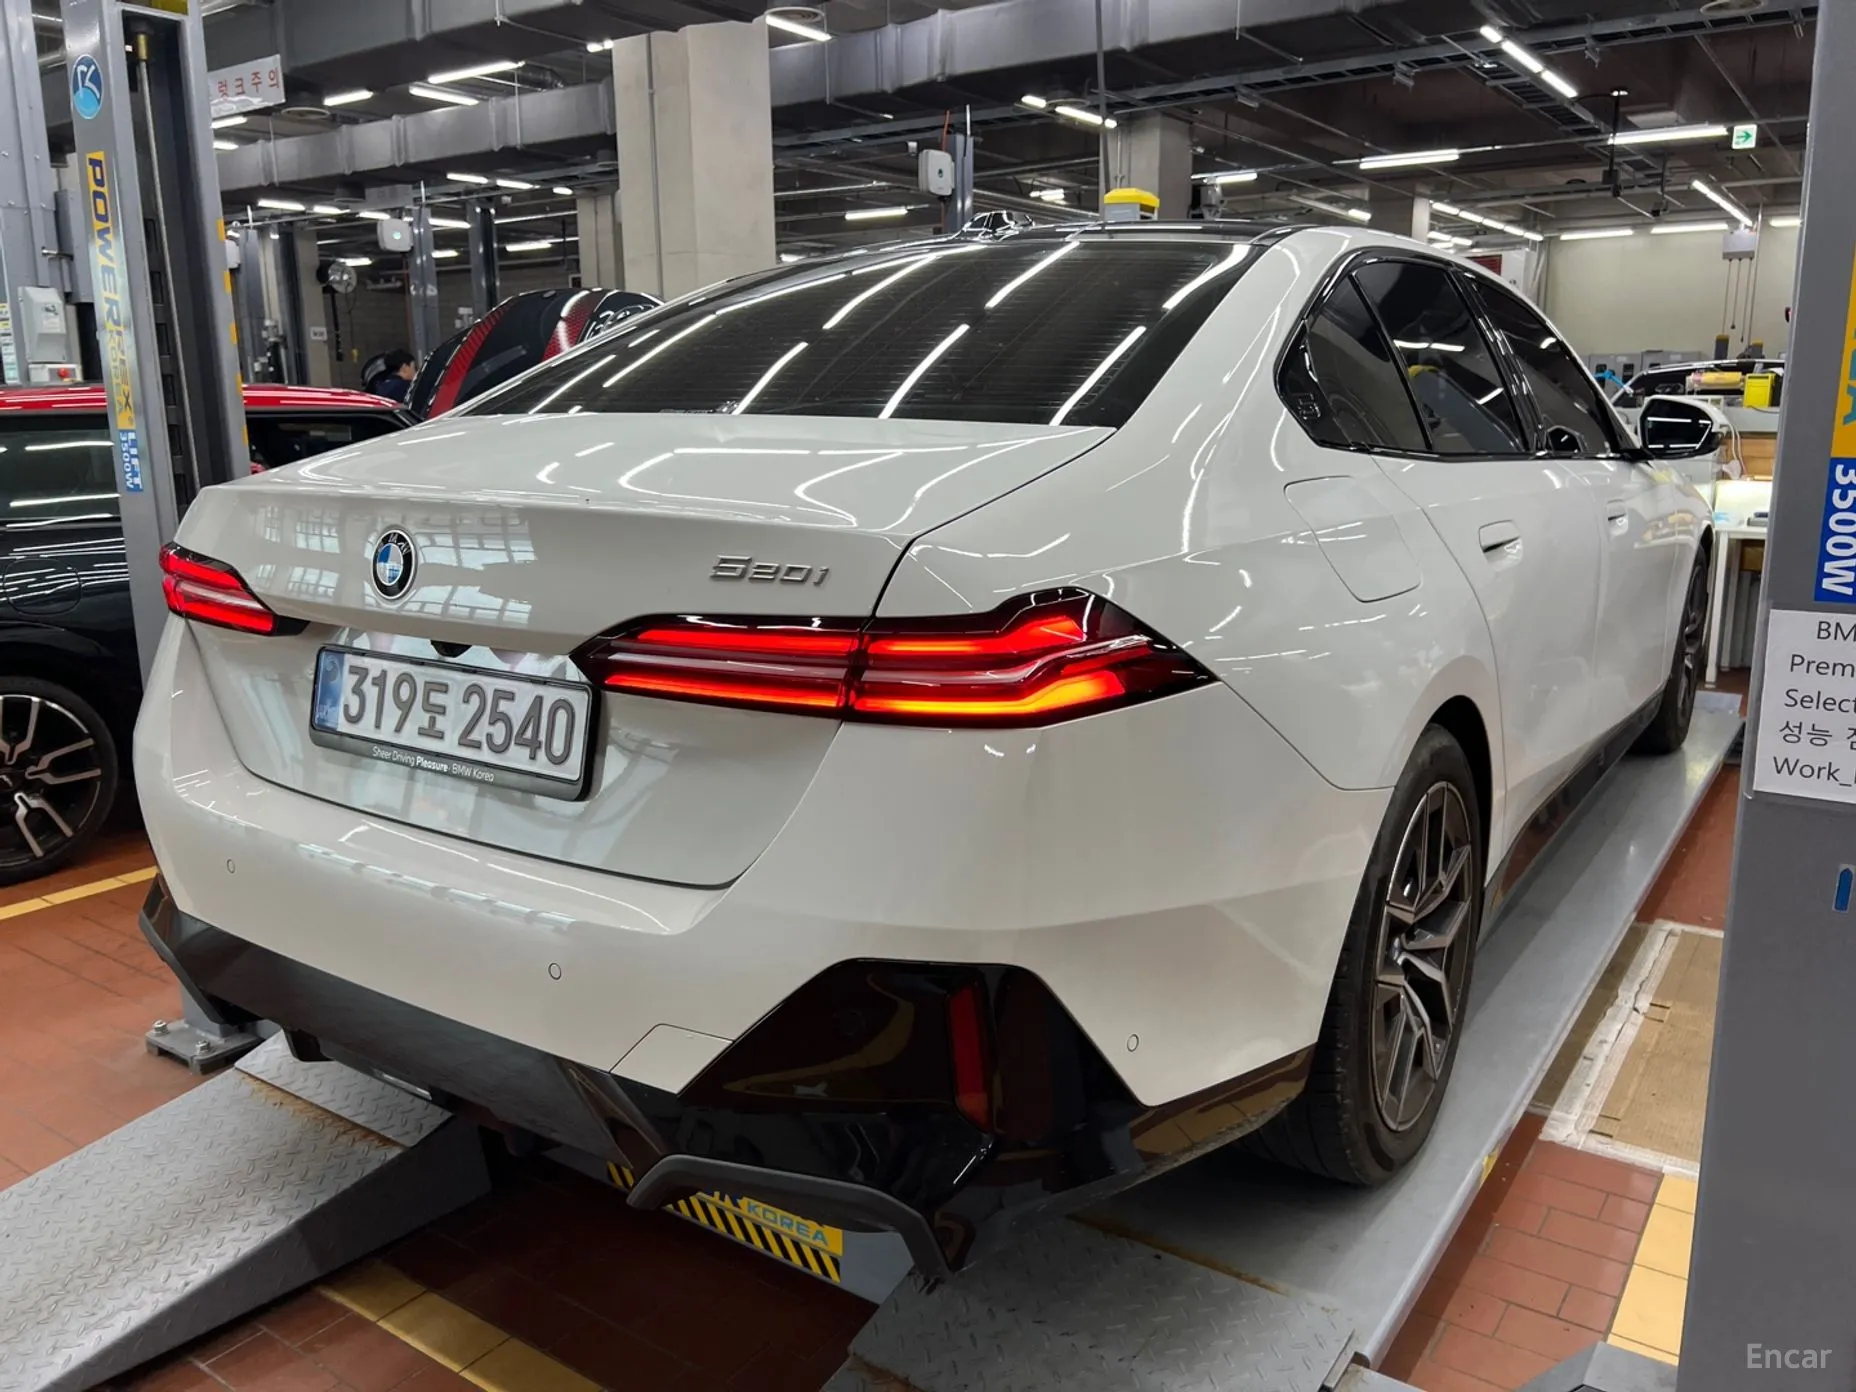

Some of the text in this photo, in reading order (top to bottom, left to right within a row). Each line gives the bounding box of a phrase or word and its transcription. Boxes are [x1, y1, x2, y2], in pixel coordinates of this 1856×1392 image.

[119, 431, 135, 489] 3500W
[128, 432, 143, 489] LIFT
[1822, 464, 1856, 596] 3500W
[343, 665, 576, 766] 319도 2540
[1779, 720, 1833, 747] 성능
[372, 746, 495, 783] Sheer Driving Pleasure BMW Korea
[1773, 756, 1856, 787] Work_
[747, 1201, 829, 1247] KOREA
